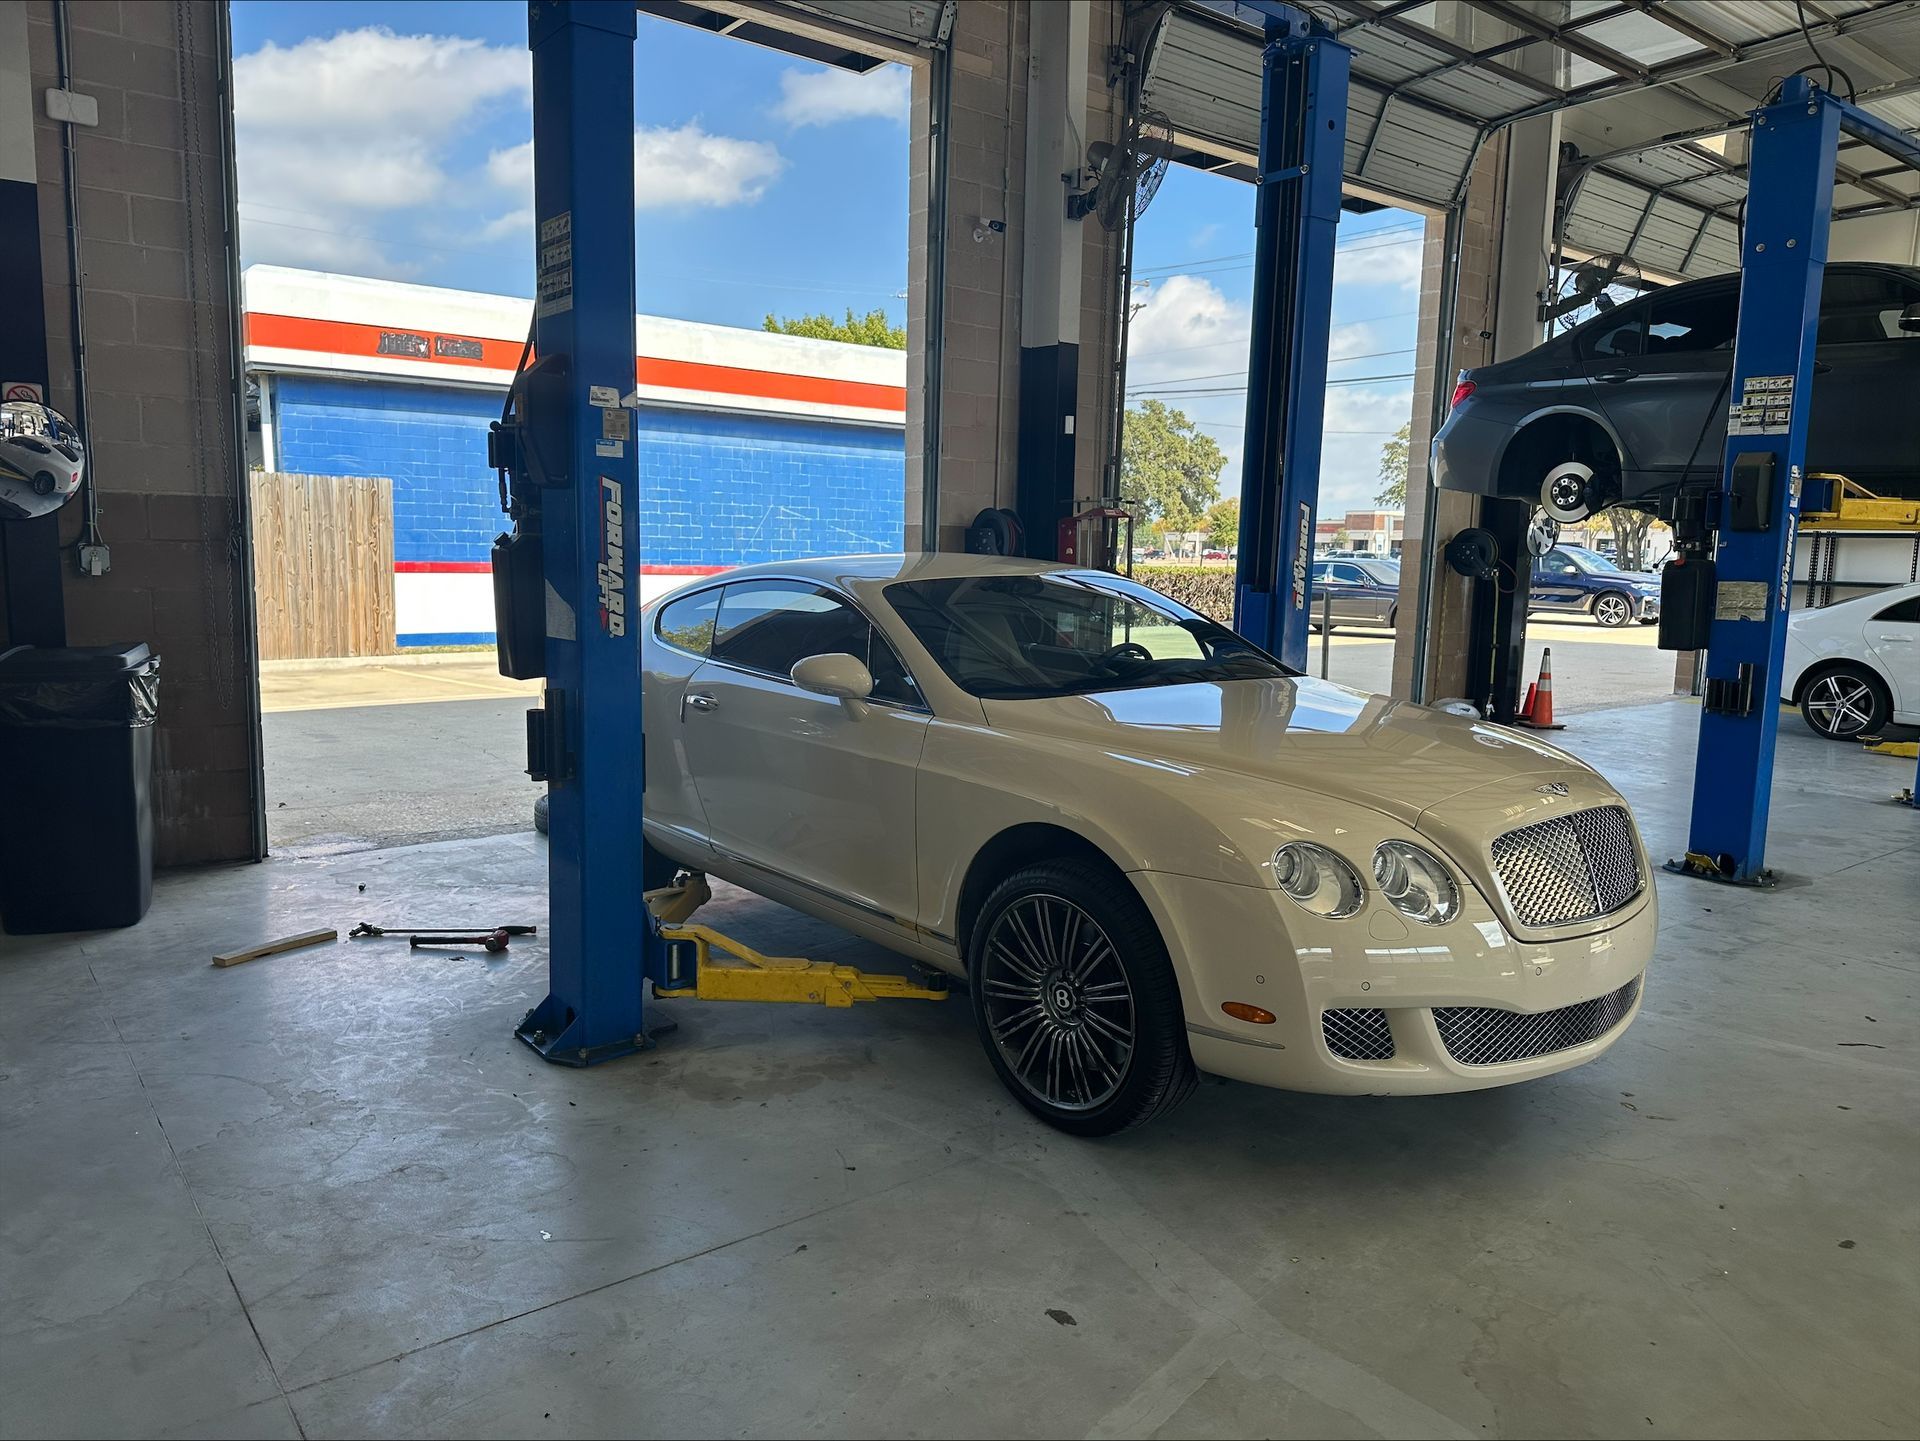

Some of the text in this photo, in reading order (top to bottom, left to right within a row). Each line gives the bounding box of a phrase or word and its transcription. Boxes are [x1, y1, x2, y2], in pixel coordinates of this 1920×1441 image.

[598, 562, 609, 609] LIFT
[601, 476, 625, 637] FORWARD
[1296, 502, 1311, 610] FORWARD
